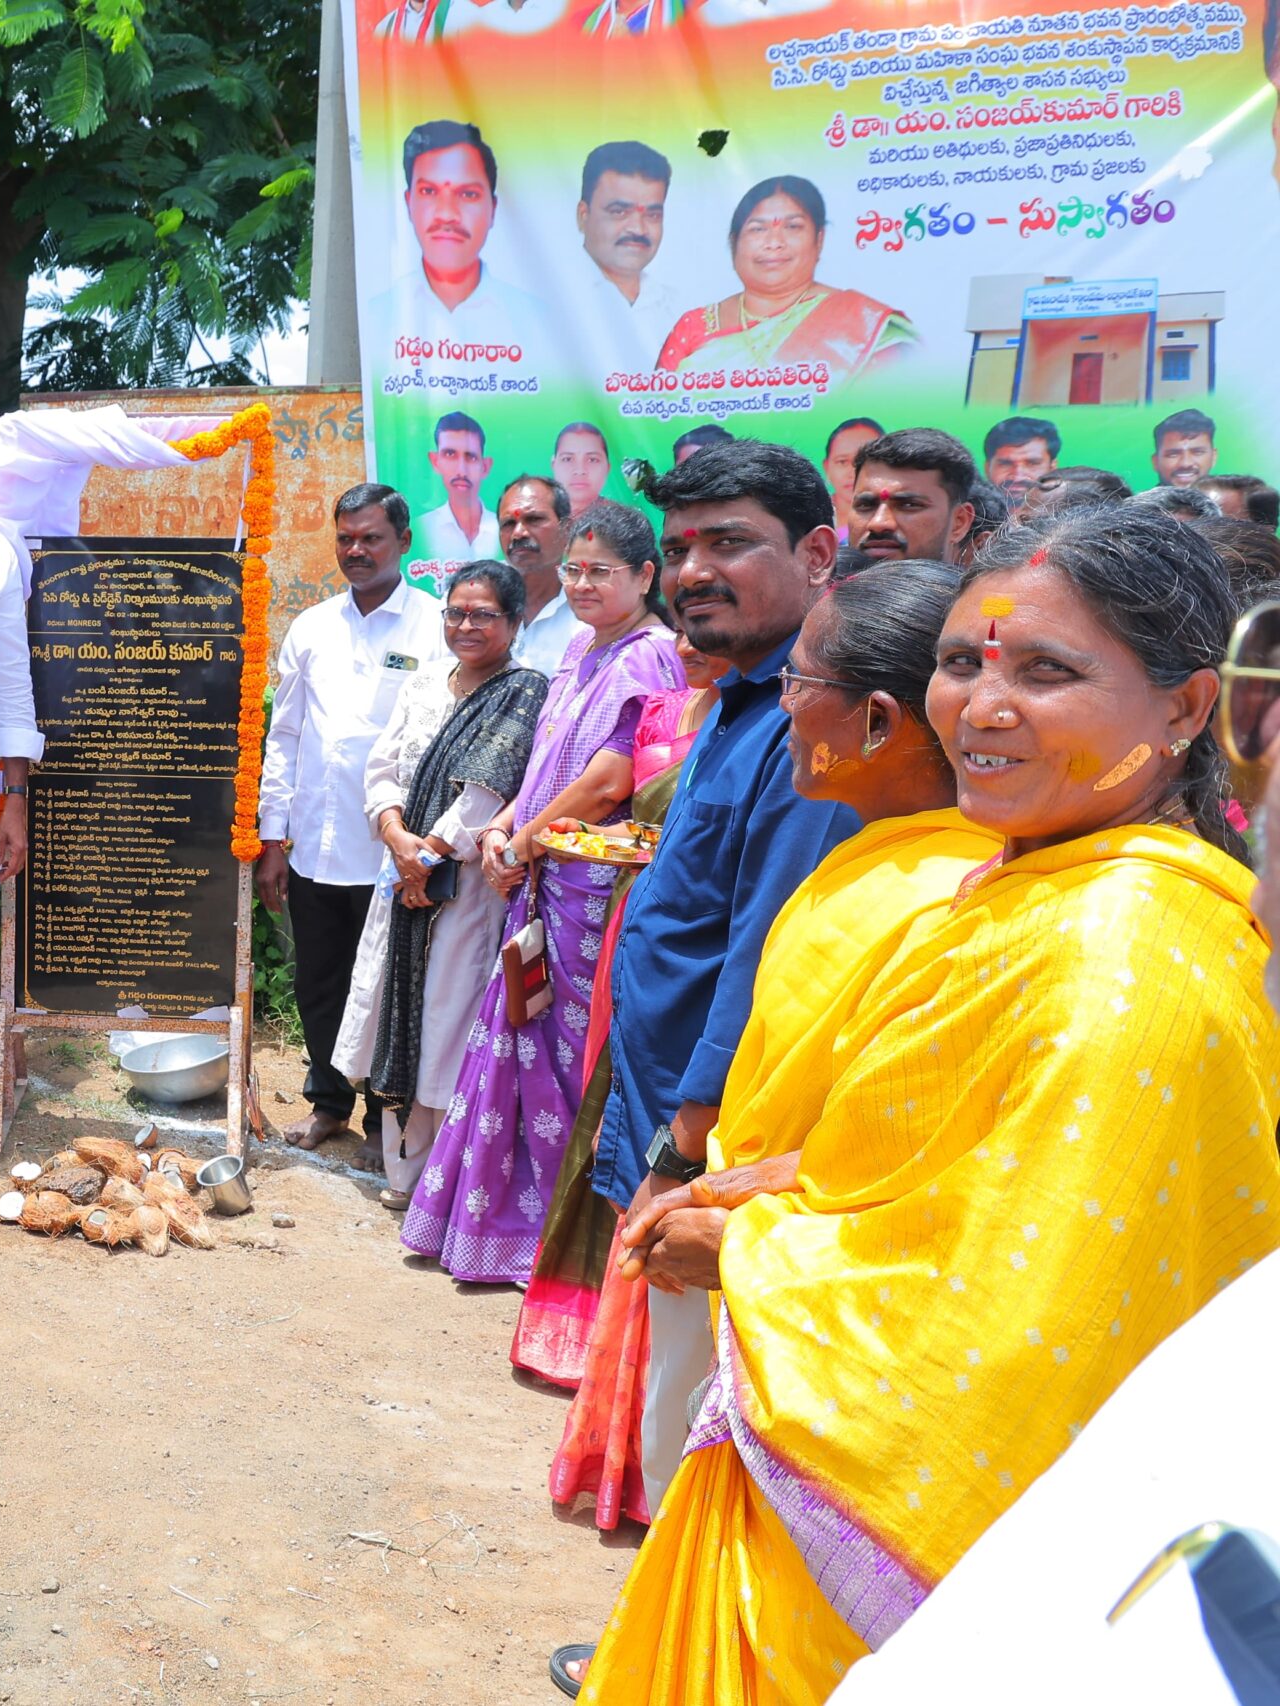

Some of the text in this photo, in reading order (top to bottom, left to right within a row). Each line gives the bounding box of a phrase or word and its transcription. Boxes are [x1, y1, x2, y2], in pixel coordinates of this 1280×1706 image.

[853, 31, 897, 48] తండా
[900, 28, 936, 48] గ్రామ
[1028, 14, 1078, 32] నూతన
[1083, 12, 1120, 32] భవన
[812, 61, 847, 87] రోడ్డు
[851, 56, 912, 77] మరియు
[915, 51, 972, 71] మహిళా
[977, 45, 1019, 65] సంఘ
[1022, 45, 1059, 65] భవన
[1065, 36, 1147, 66] శంకుస్థాపన
[1152, 30, 1241, 58] కార్యక్రమానికి
[956, 71, 1019, 97] జగిత్యాల
[1023, 70, 1066, 88] శాసన
[1070, 68, 1125, 90] సభ్యులు
[826, 113, 847, 147] శ్రీ
[1125, 90, 1181, 119] గారికి
[869, 145, 929, 165] మరియు
[857, 158, 1146, 194] అధికారులకు, నాయకులకు, గ్రామ ప్రజలకు
[855, 203, 975, 252] స్వాగతం
[1019, 190, 1176, 239] సుస్వాగతం
[395, 336, 522, 366] గడ్డం గంగారాం
[501, 377, 538, 392] తాండ
[606, 363, 829, 393] బొడుగం రజిత తిరుపతిరెడ్డి
[622, 399, 642, 414] ఉప
[646, 397, 693, 418] సర్పంచ్,
[774, 394, 811, 408] తాండ
[82, 592, 90, 602] &
[114, 640, 166, 660] సంజయ్
[169, 640, 213, 661] కుమార్
[220, 650, 237, 662] గారు
[140, 686, 167, 695] కుమార్
[157, 709, 178, 717] రావు
[141, 752, 171, 760] కుమార్
